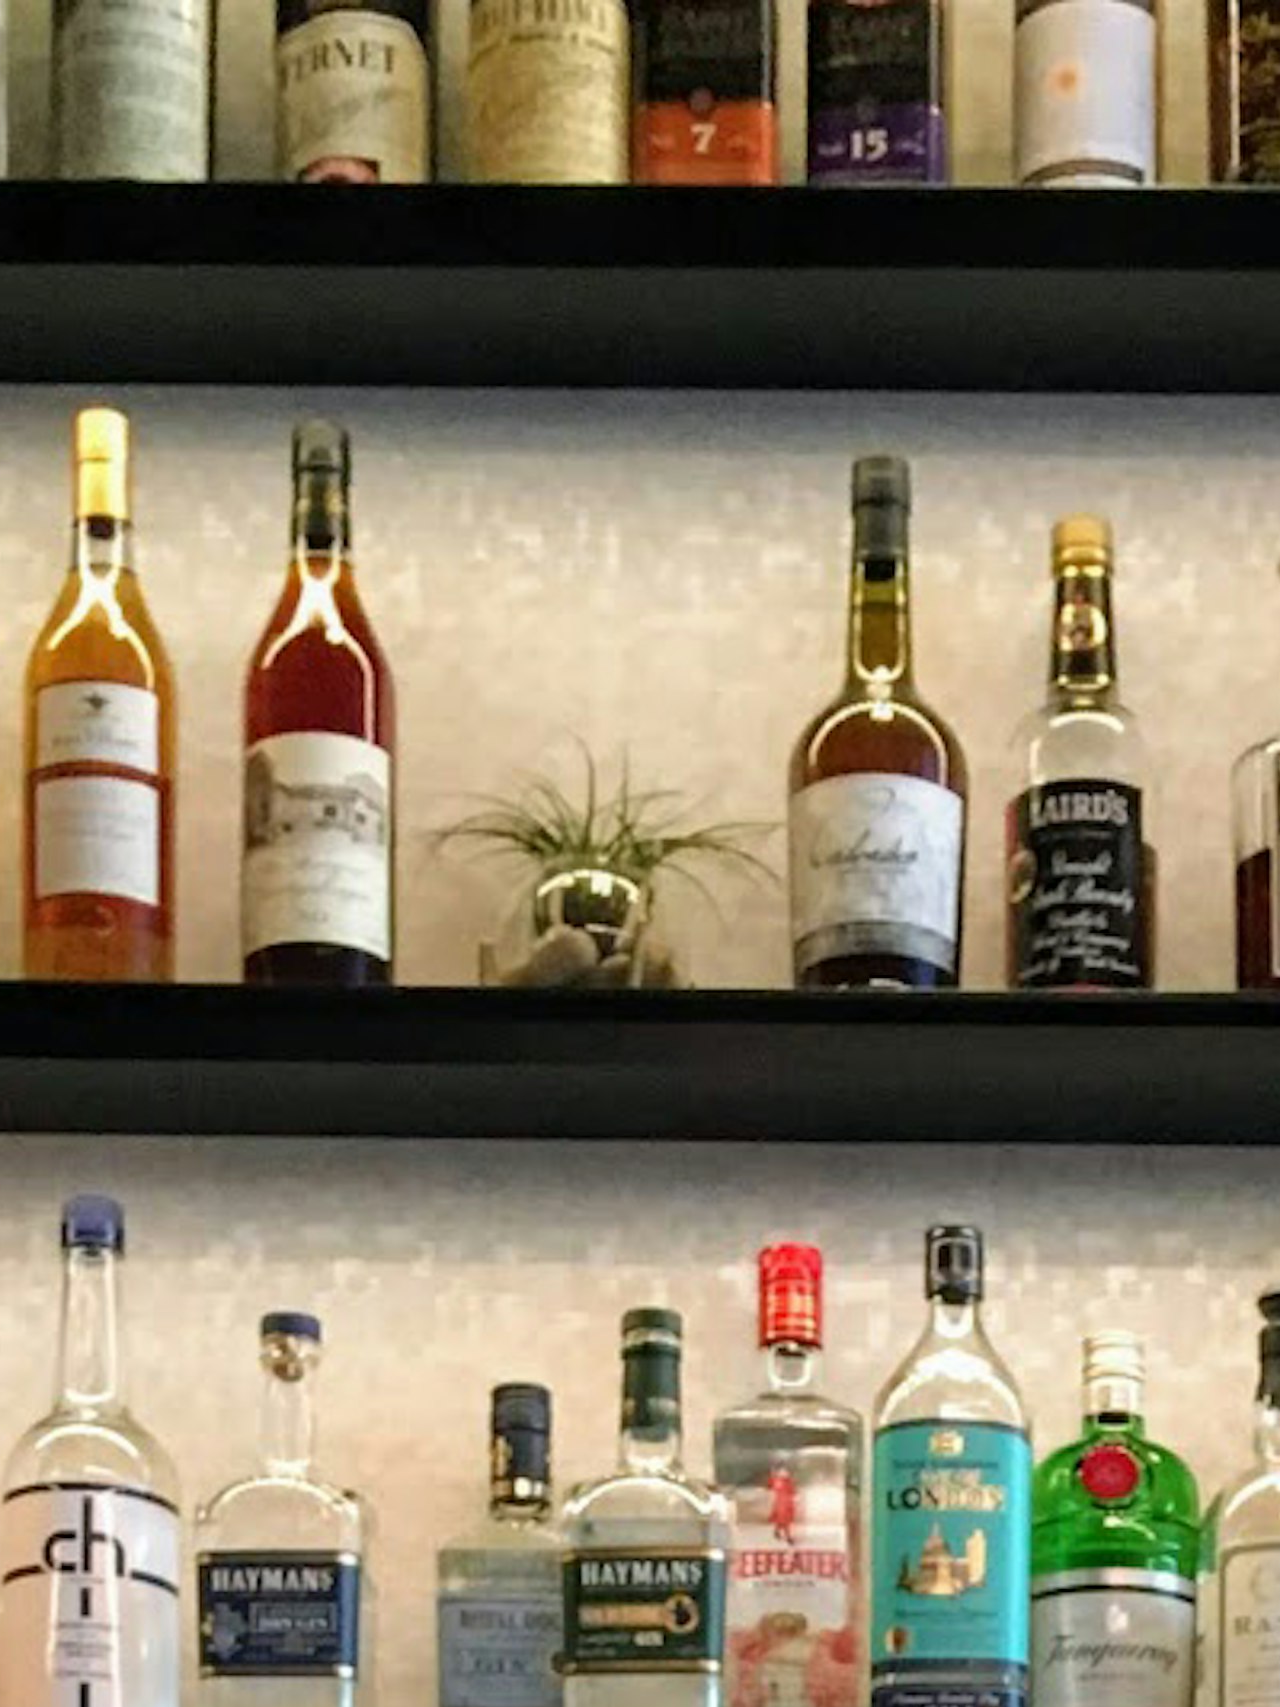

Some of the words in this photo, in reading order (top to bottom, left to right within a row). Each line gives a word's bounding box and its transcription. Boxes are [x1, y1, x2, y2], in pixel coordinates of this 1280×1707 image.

[691, 123, 716, 154] 7
[849, 129, 887, 160] 15
[1029, 790, 1129, 828] LAIRD'S
[43, 1496, 125, 1578] ch
